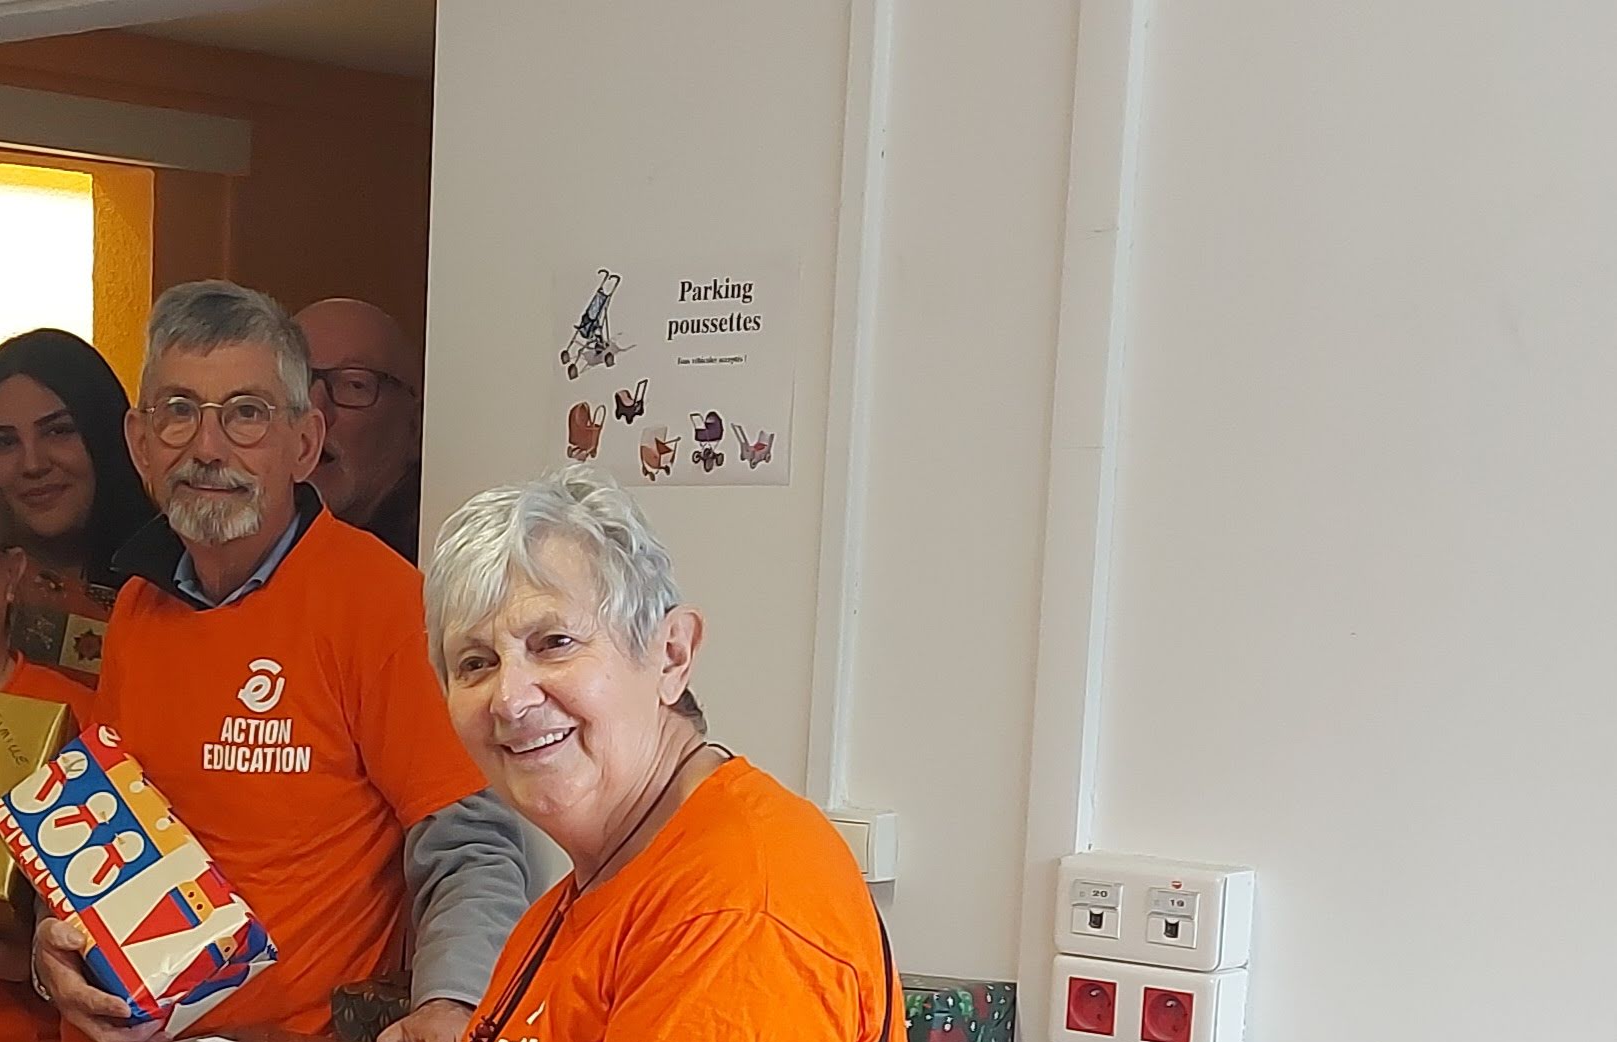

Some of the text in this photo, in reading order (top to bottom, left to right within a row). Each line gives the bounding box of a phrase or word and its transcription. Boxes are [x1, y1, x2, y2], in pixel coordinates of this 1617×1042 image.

[679, 277, 754, 304] Parking
[667, 312, 762, 341] poussettes
[220, 716, 293, 745] ACTION
[203, 743, 311, 773] EDUCATION
[1092, 889, 1108, 898] 20
